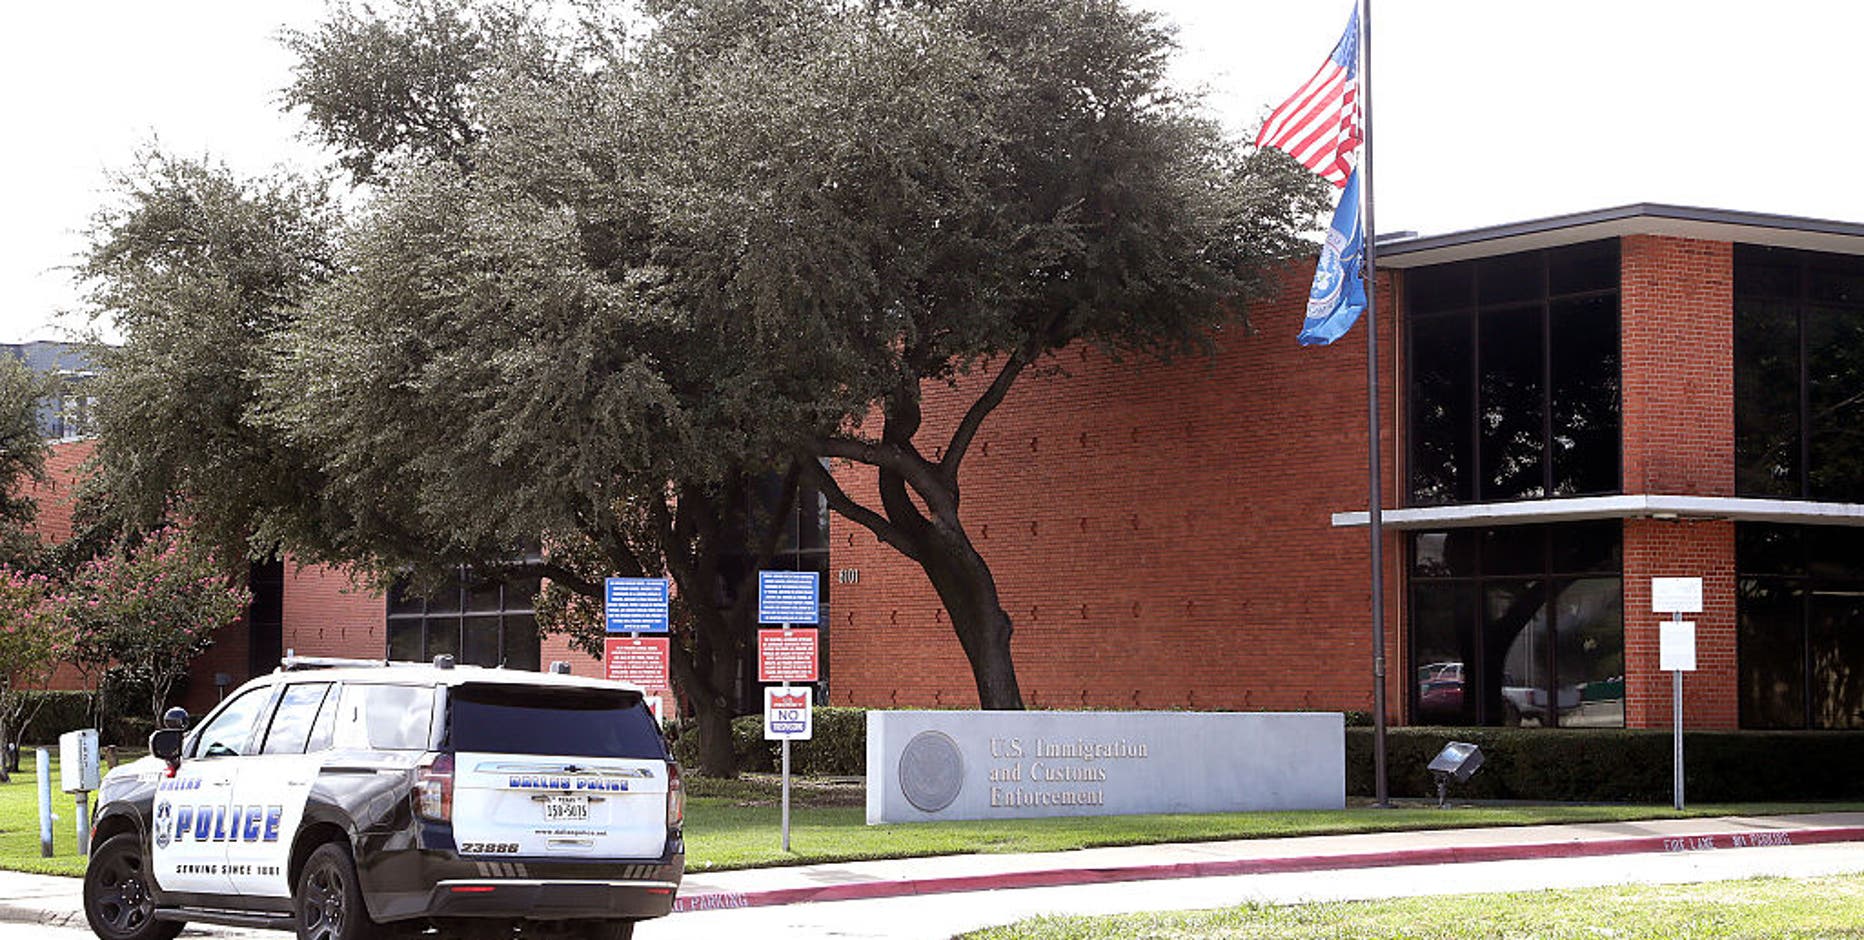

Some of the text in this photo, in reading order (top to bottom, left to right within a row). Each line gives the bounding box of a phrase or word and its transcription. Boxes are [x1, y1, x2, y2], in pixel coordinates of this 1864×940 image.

[778, 710, 798, 721] NO
[990, 737, 1149, 761] U.S. Immigration
[990, 761, 1107, 782] and Customs
[509, 775, 629, 791] DALLAS POLICE
[990, 786, 1105, 808] Enforcement
[174, 804, 283, 842] POLICE
[176, 864, 218, 875] SERVING
[221, 865, 252, 875] SINCE
[691, 893, 749, 911] PARKING
